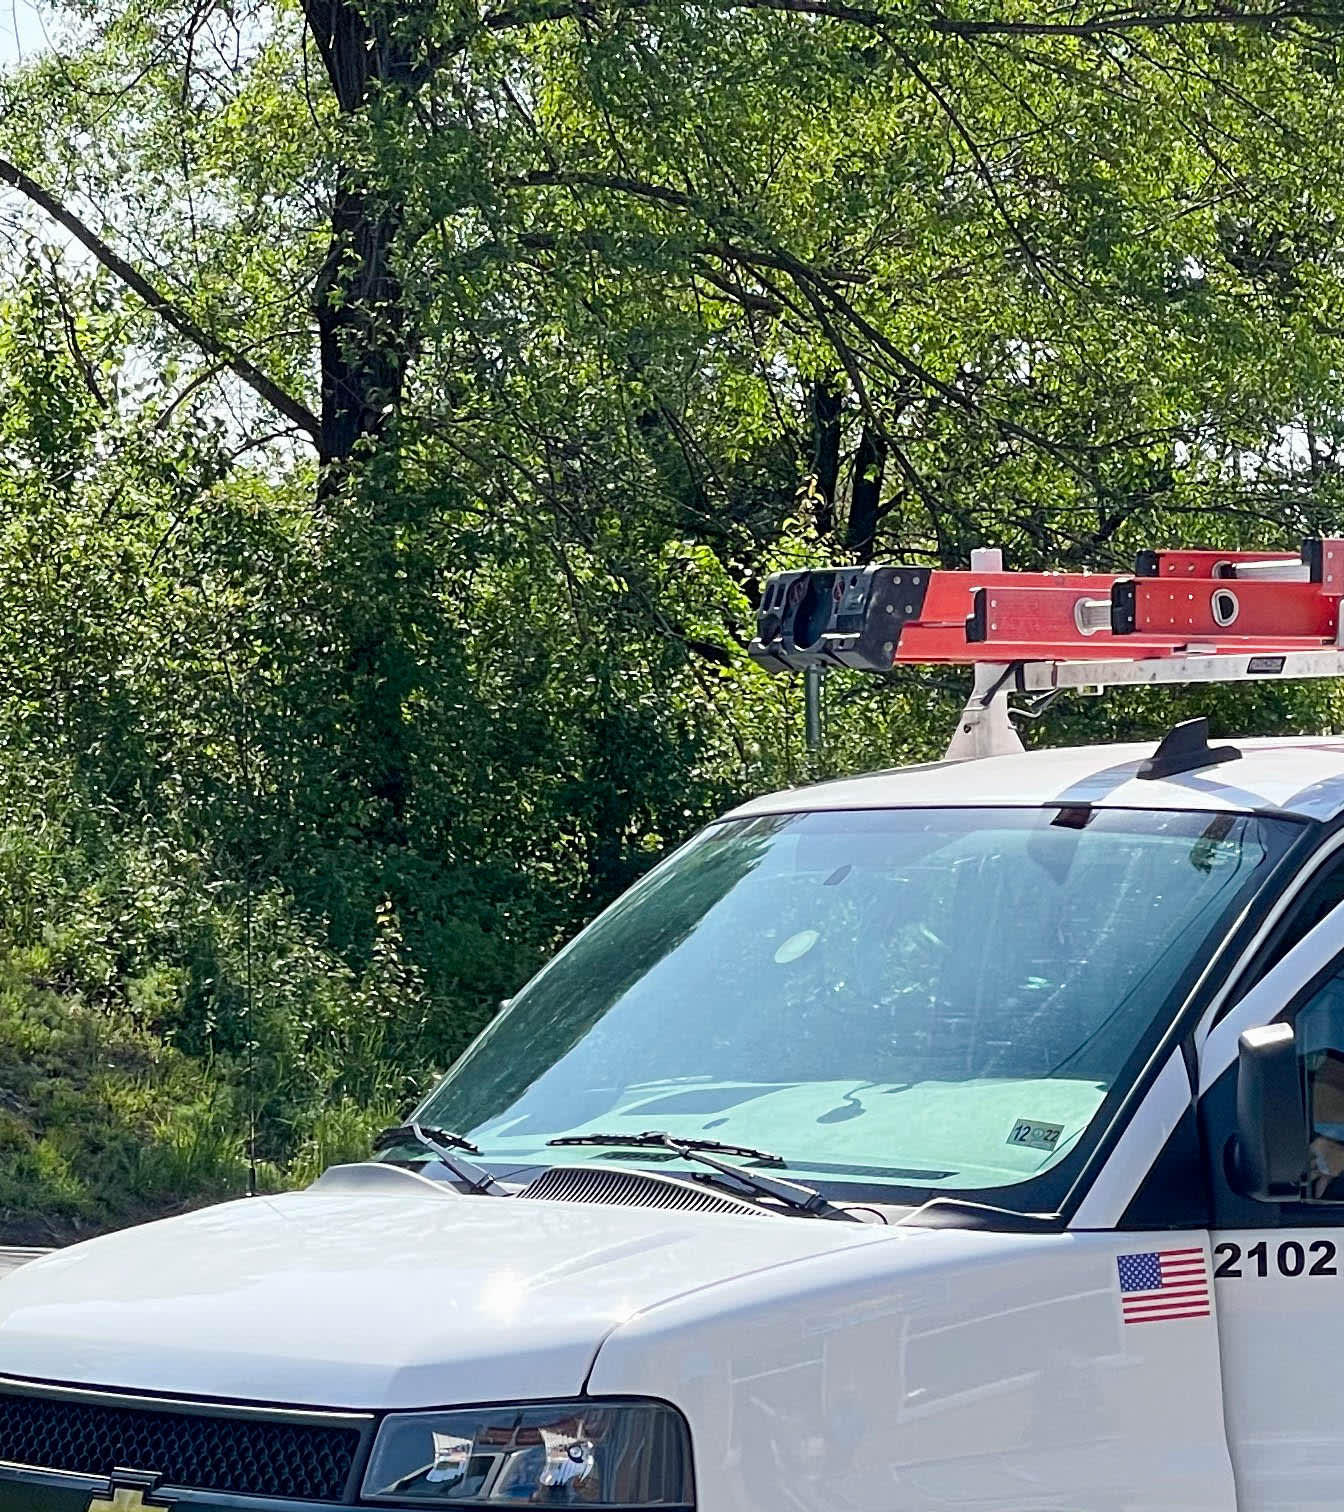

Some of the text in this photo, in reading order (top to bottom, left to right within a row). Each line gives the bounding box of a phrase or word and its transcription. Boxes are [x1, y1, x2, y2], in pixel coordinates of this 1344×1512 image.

[1013, 1125, 1060, 1142] 12 22
[1214, 1240, 1337, 1278] 2102
